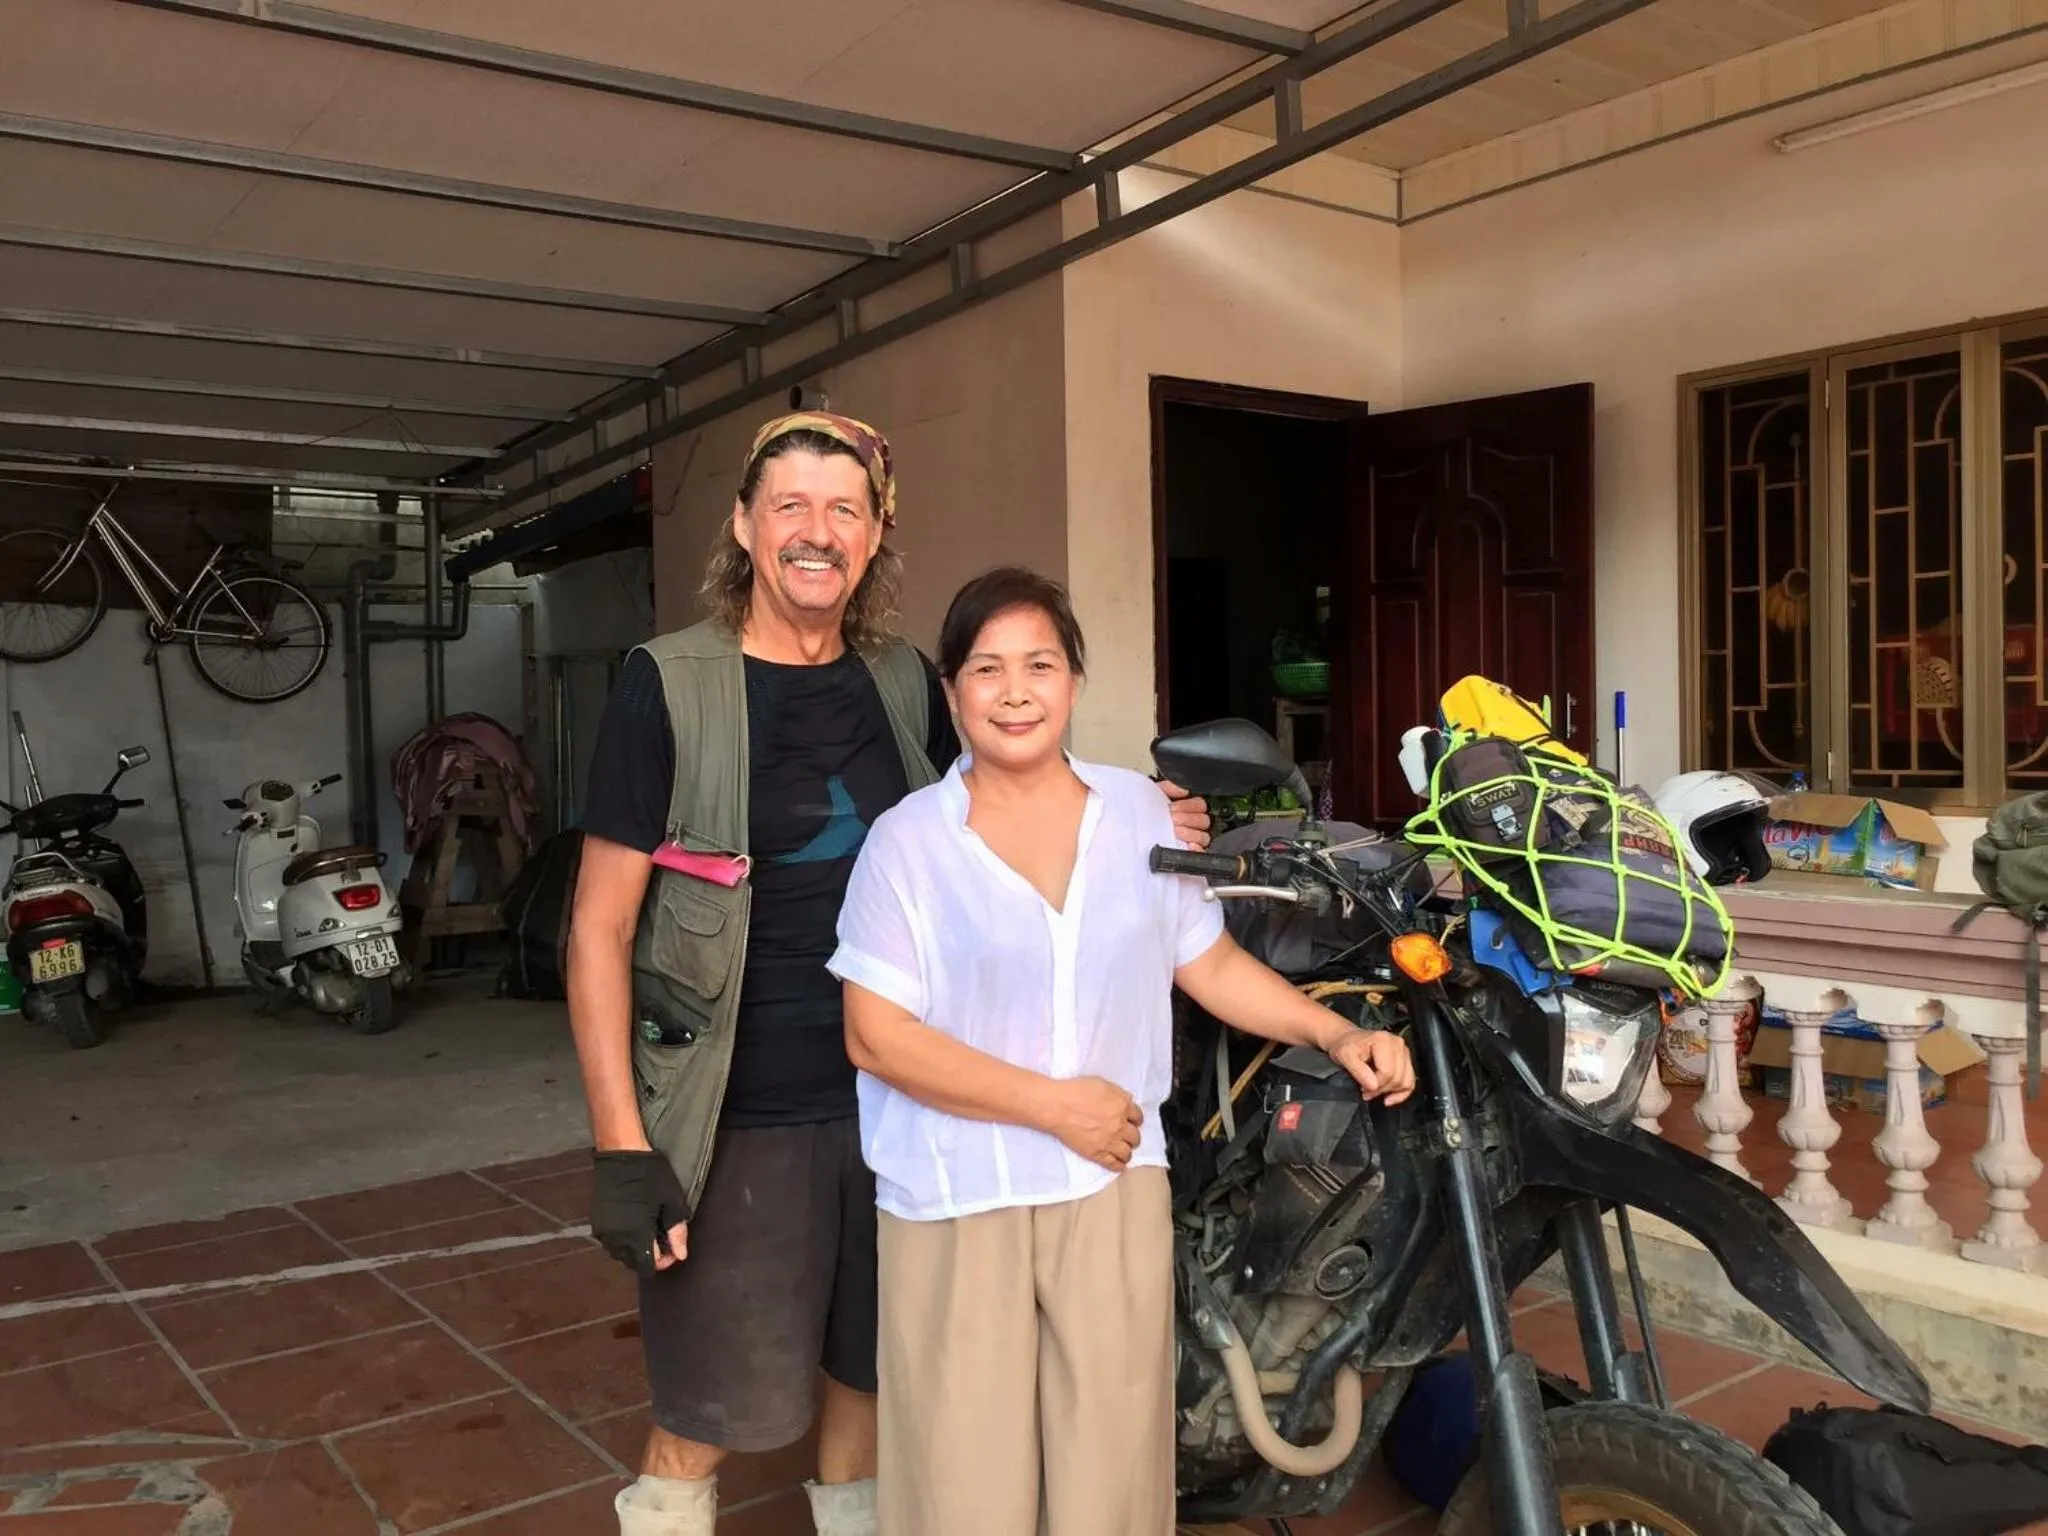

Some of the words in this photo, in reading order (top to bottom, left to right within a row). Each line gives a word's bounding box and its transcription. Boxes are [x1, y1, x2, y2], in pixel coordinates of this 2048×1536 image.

[1477, 786, 1514, 807] SWAT
[38, 944, 75, 964] 12-K6
[355, 938, 389, 957] 12-01
[39, 959, 77, 979] 6996
